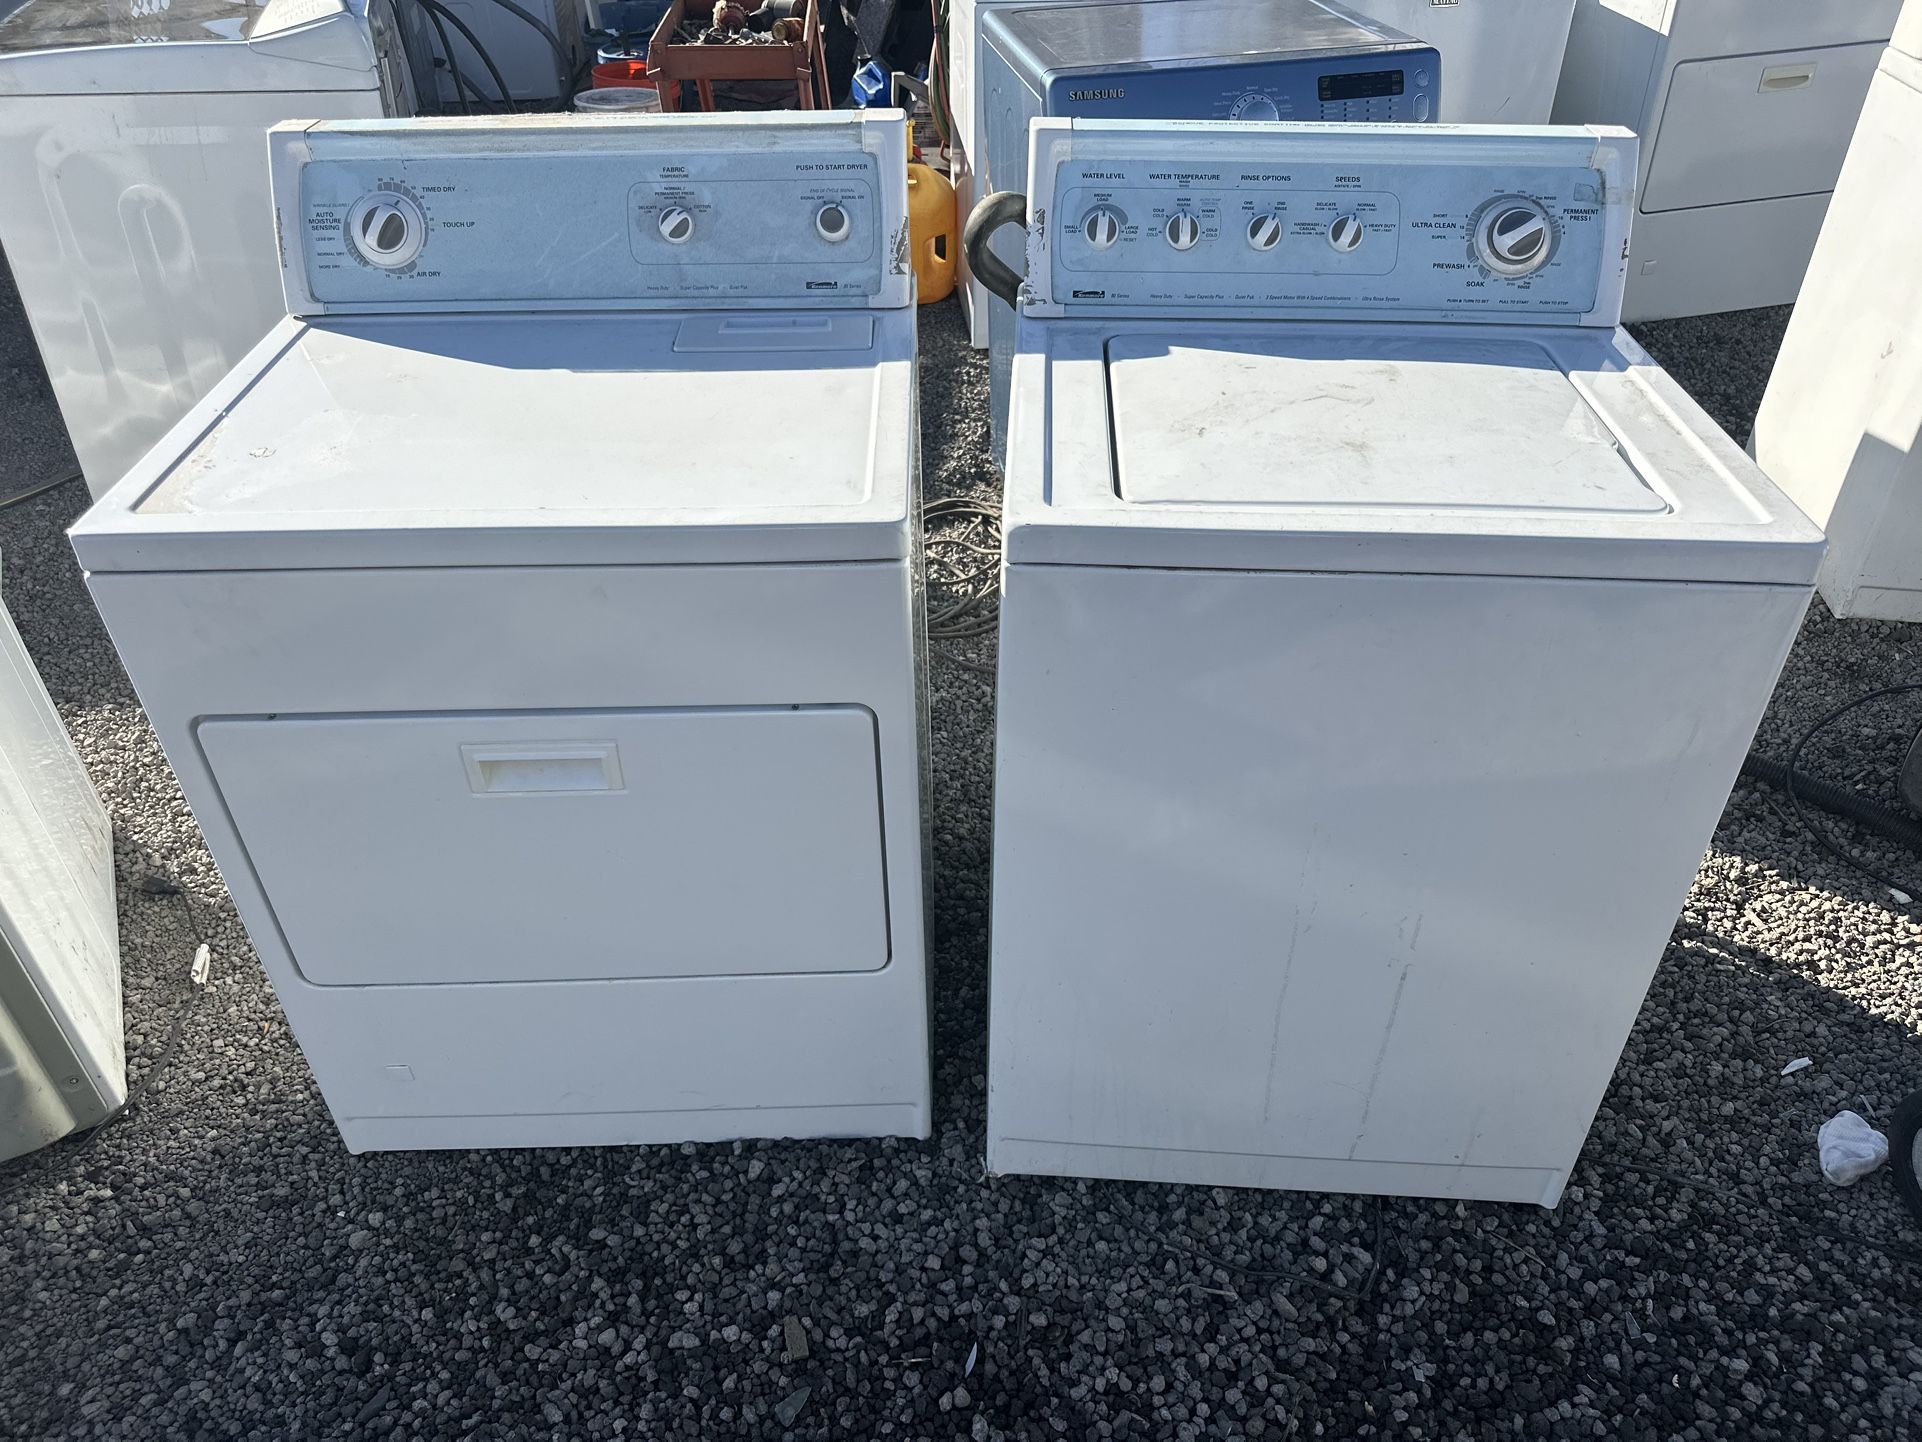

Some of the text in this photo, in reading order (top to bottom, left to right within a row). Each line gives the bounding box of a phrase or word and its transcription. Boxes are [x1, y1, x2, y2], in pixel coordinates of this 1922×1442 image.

[1069, 88, 1125, 101] SAMSUNG
[1261, 174, 1291, 182] OPTIONS
[1432, 262, 1465, 270] PREWASH
